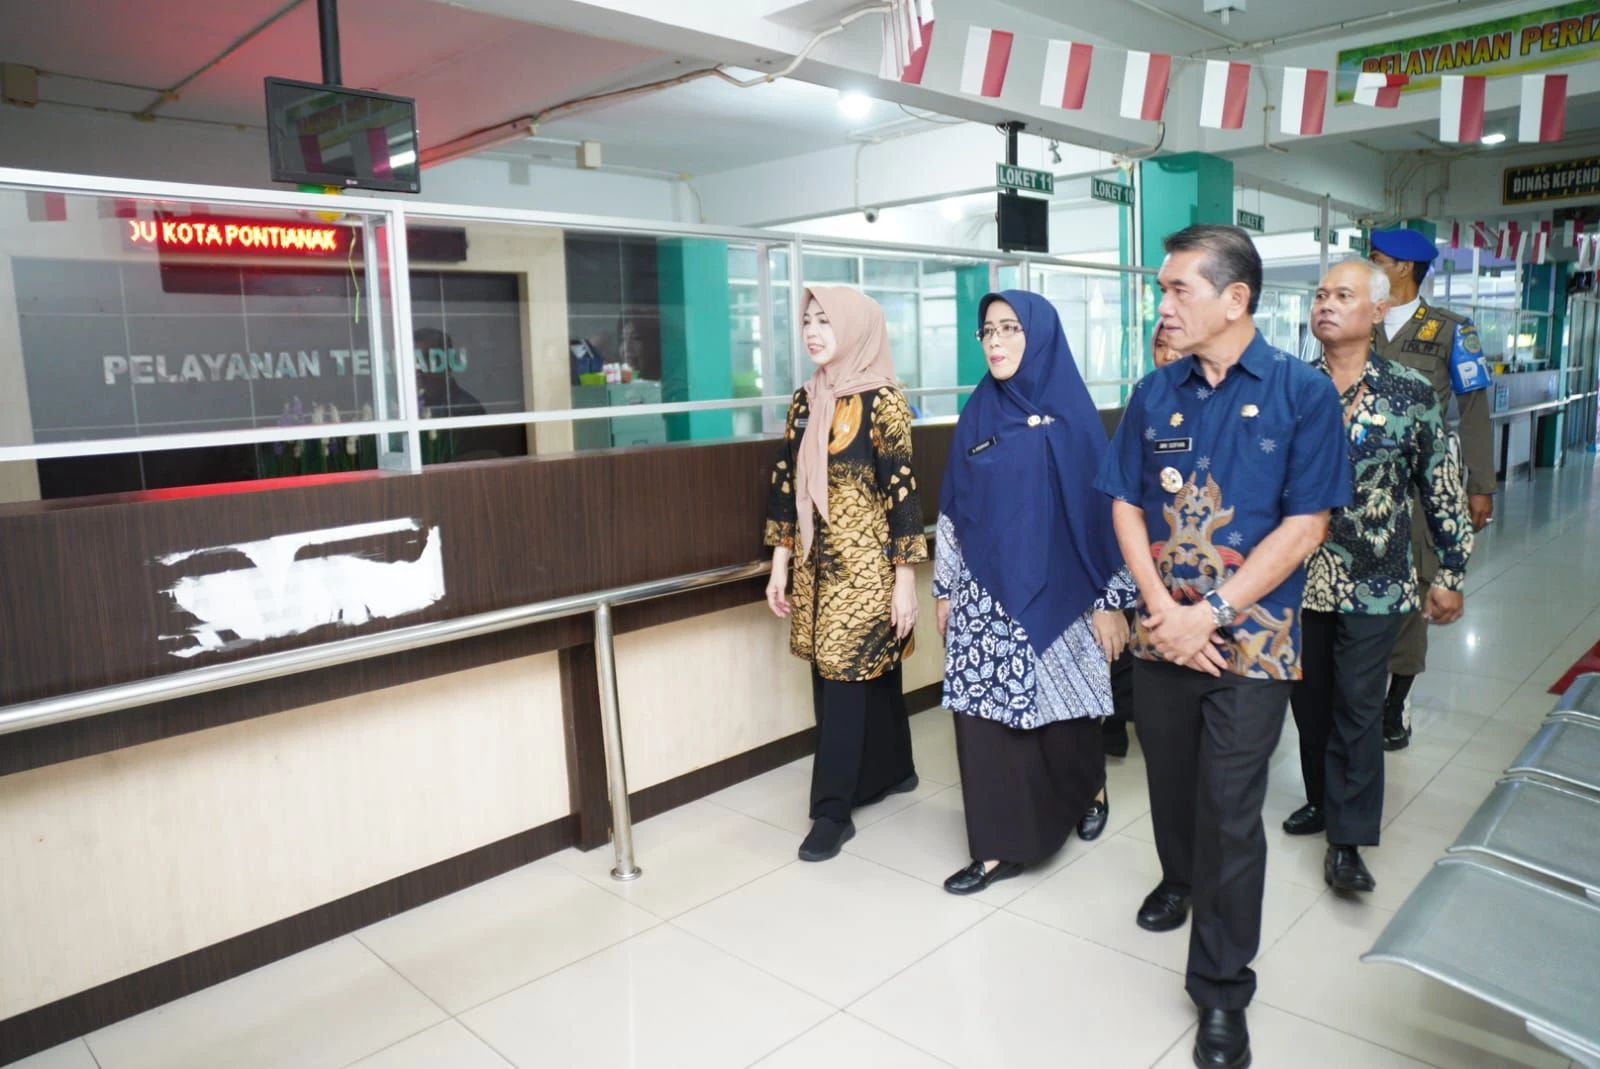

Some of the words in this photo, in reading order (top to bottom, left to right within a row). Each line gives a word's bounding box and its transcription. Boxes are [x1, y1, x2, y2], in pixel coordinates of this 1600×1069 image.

[999, 166, 1037, 188] LOKET
[1039, 174, 1052, 191] 11
[1094, 179, 1122, 200] LOKET
[1124, 186, 1135, 204] 10
[1513, 173, 1550, 193] DINAS
[1552, 167, 1600, 189] KEPEND
[162, 221, 223, 245] KOTA
[225, 224, 337, 251] PONTIANAK
[103, 350, 322, 385] PELAYANAN
[330, 348, 468, 375] TERADU
